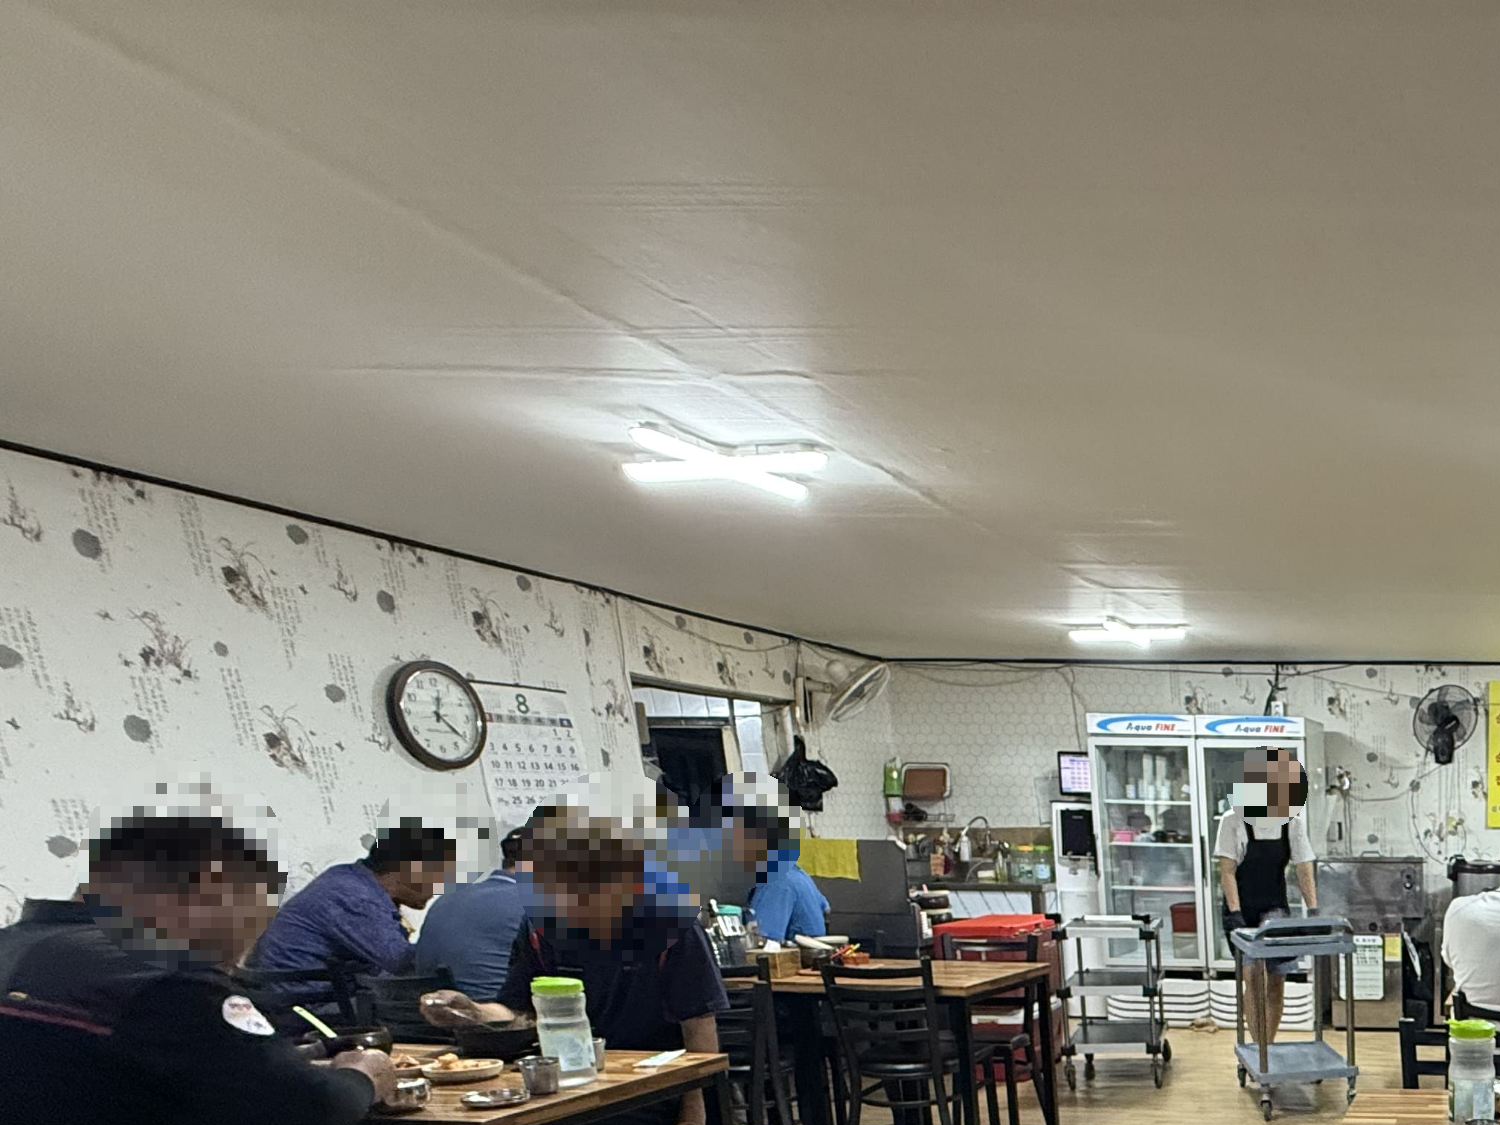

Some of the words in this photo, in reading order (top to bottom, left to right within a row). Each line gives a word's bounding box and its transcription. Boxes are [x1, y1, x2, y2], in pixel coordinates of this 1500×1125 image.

[515, 694, 529, 714] 8
[1126, 722, 1152, 732] Aqua
[1155, 722, 1176, 731] FINE
[1234, 724, 1262, 734] Aqua
[1264, 724, 1285, 733] FINE
